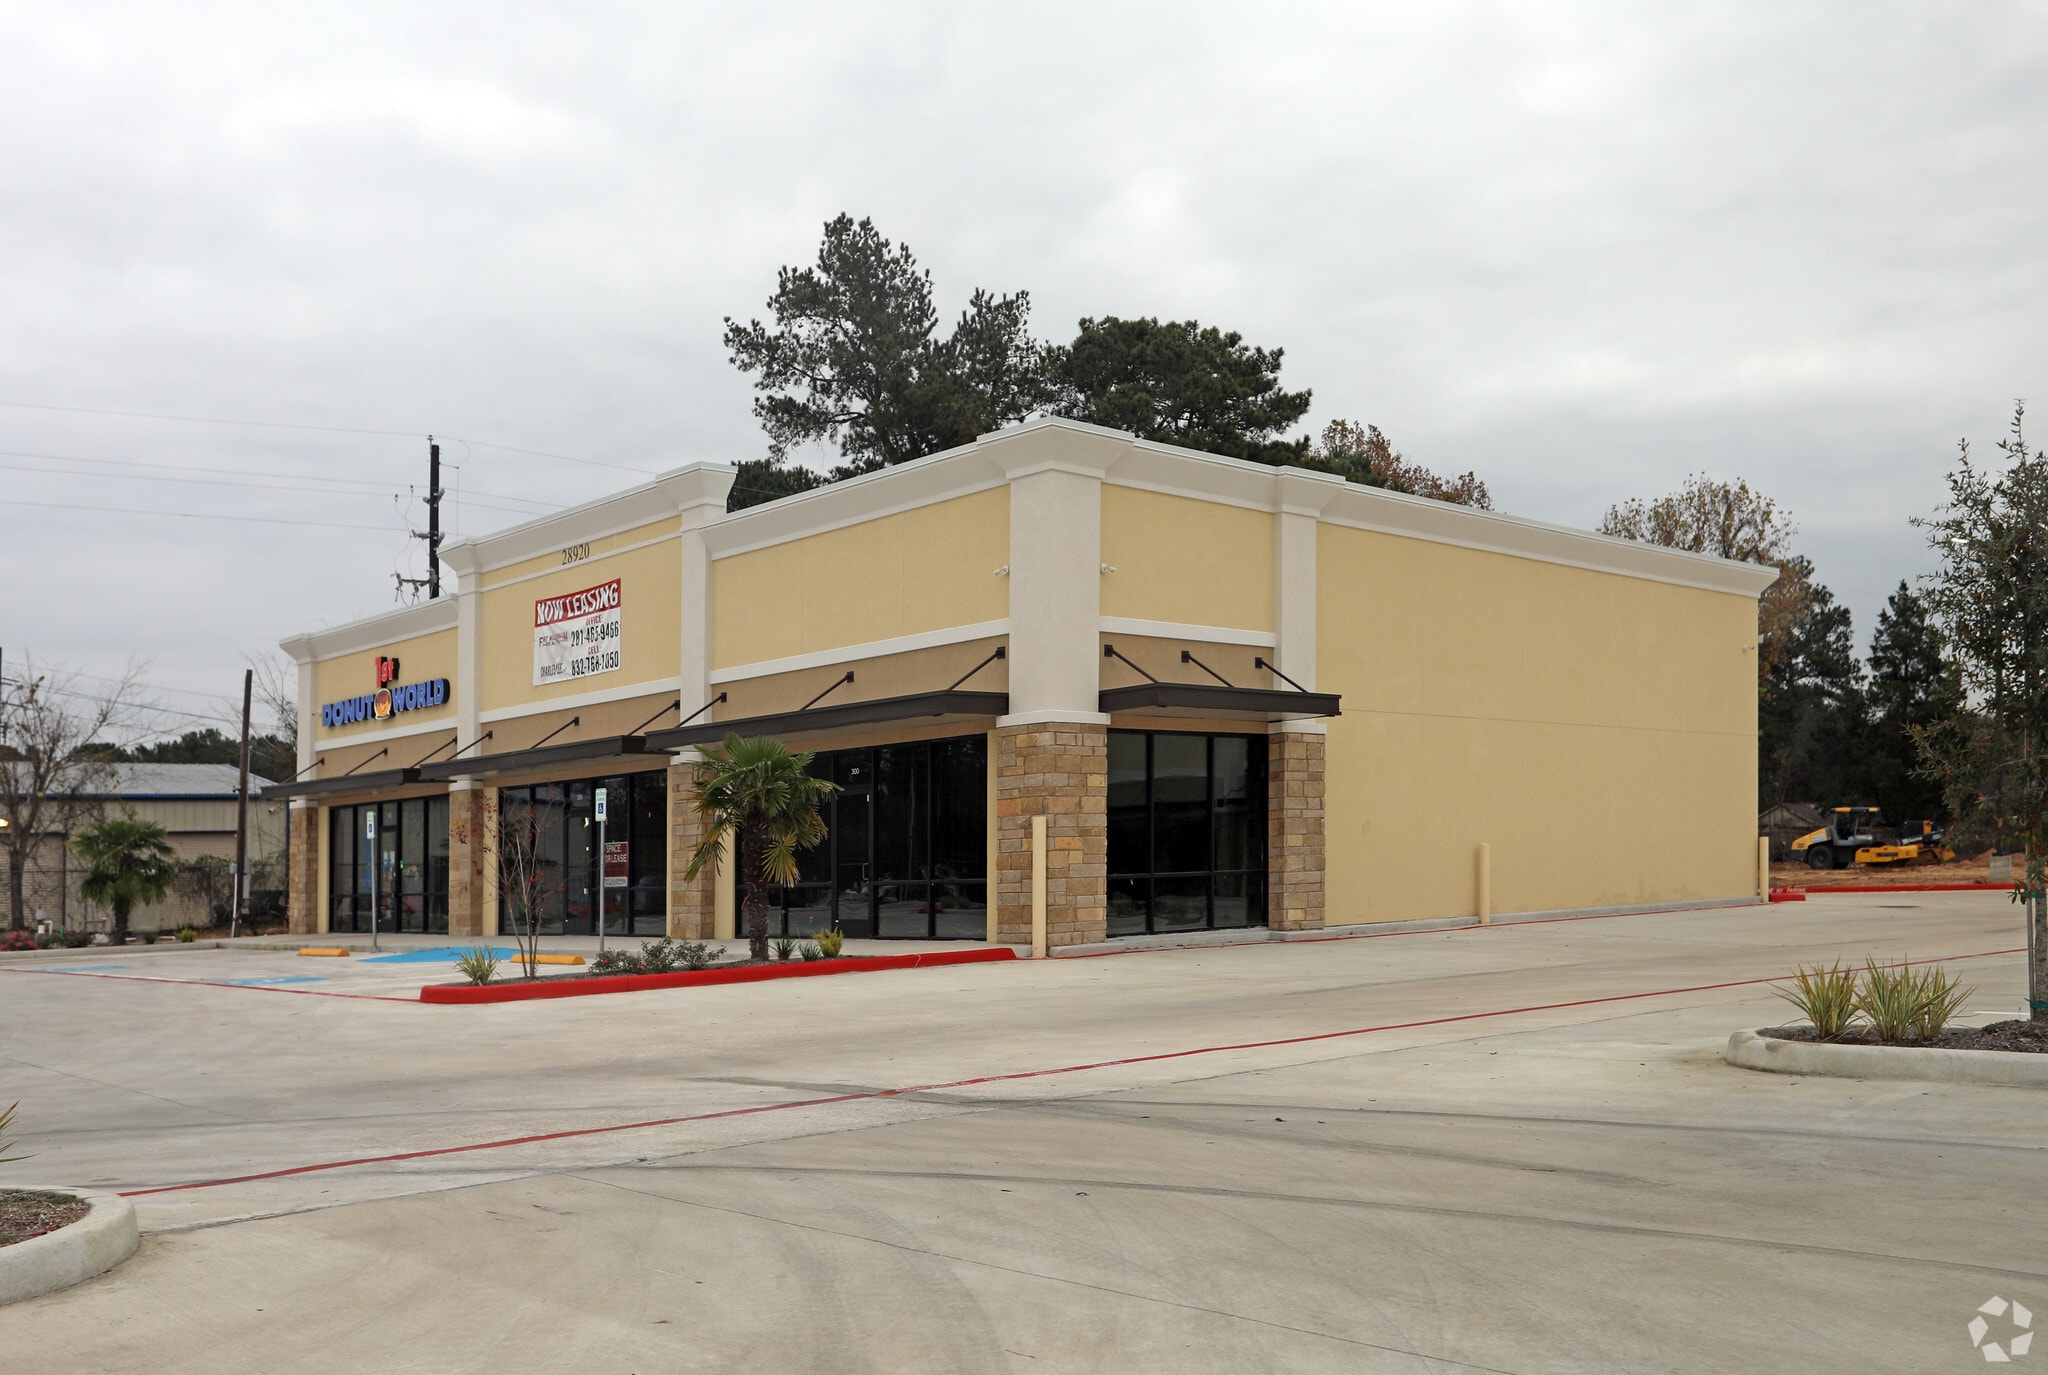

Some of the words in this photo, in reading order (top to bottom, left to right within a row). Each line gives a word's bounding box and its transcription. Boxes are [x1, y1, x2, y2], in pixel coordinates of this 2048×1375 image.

[561, 542, 590, 565] 28920
[537, 599, 564, 625] NOW
[566, 582, 619, 618] LEASING
[570, 620, 619, 647] 281-465-9466
[376, 656, 398, 688] 1st
[322, 694, 375, 728] DONUT
[391, 678, 451, 713] WORLD
[612, 854, 627, 862] LEASE
